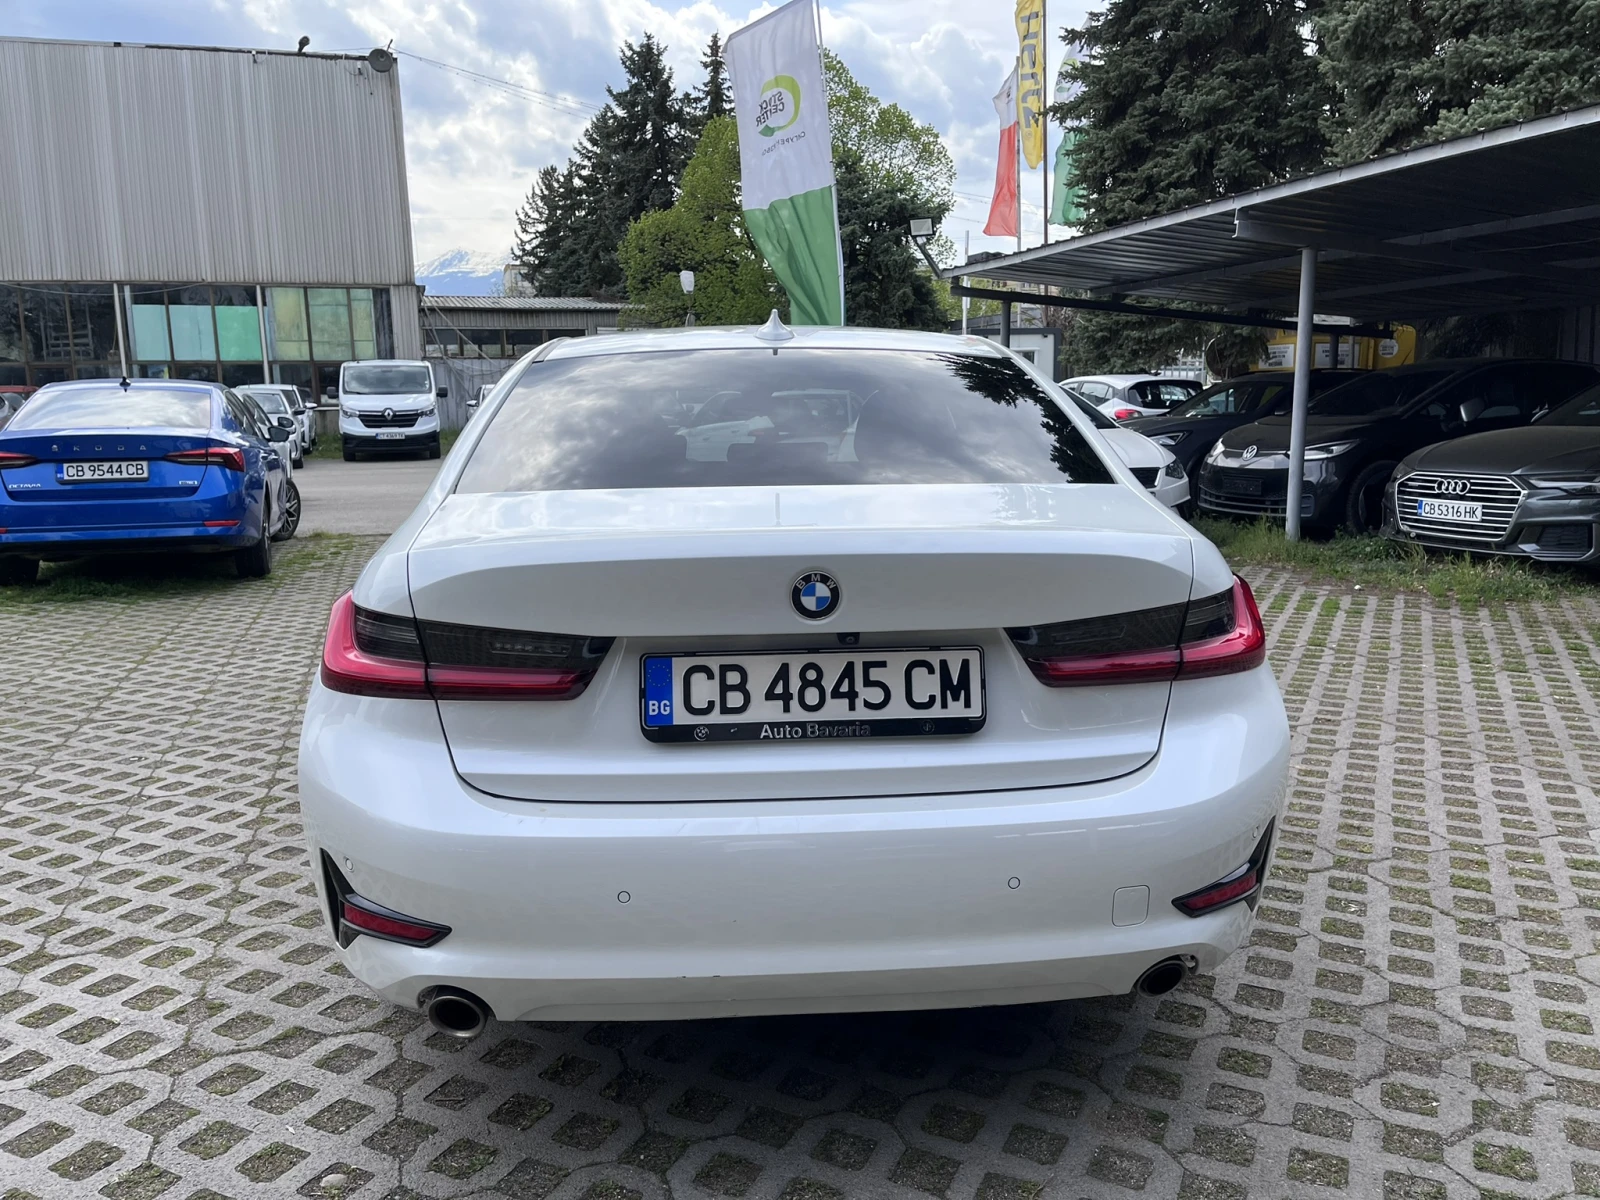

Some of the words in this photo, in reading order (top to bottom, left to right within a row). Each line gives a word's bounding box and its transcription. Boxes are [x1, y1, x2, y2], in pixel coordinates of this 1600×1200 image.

[1020, 11, 1041, 129] Hertz
[66, 465, 85, 478] CB
[88, 464, 123, 477] 9544
[126, 463, 145, 476] CB
[1423, 502, 1436, 515] CB
[1437, 504, 1462, 518] 5316
[1463, 506, 1479, 519] HK
[795, 573, 837, 590] BMW
[683, 664, 751, 716] CB
[764, 660, 892, 713] 4845
[904, 658, 972, 710] CM
[648, 700, 671, 716] BG
[760, 724, 802, 739] Auto
[806, 722, 871, 738] Bavaria
